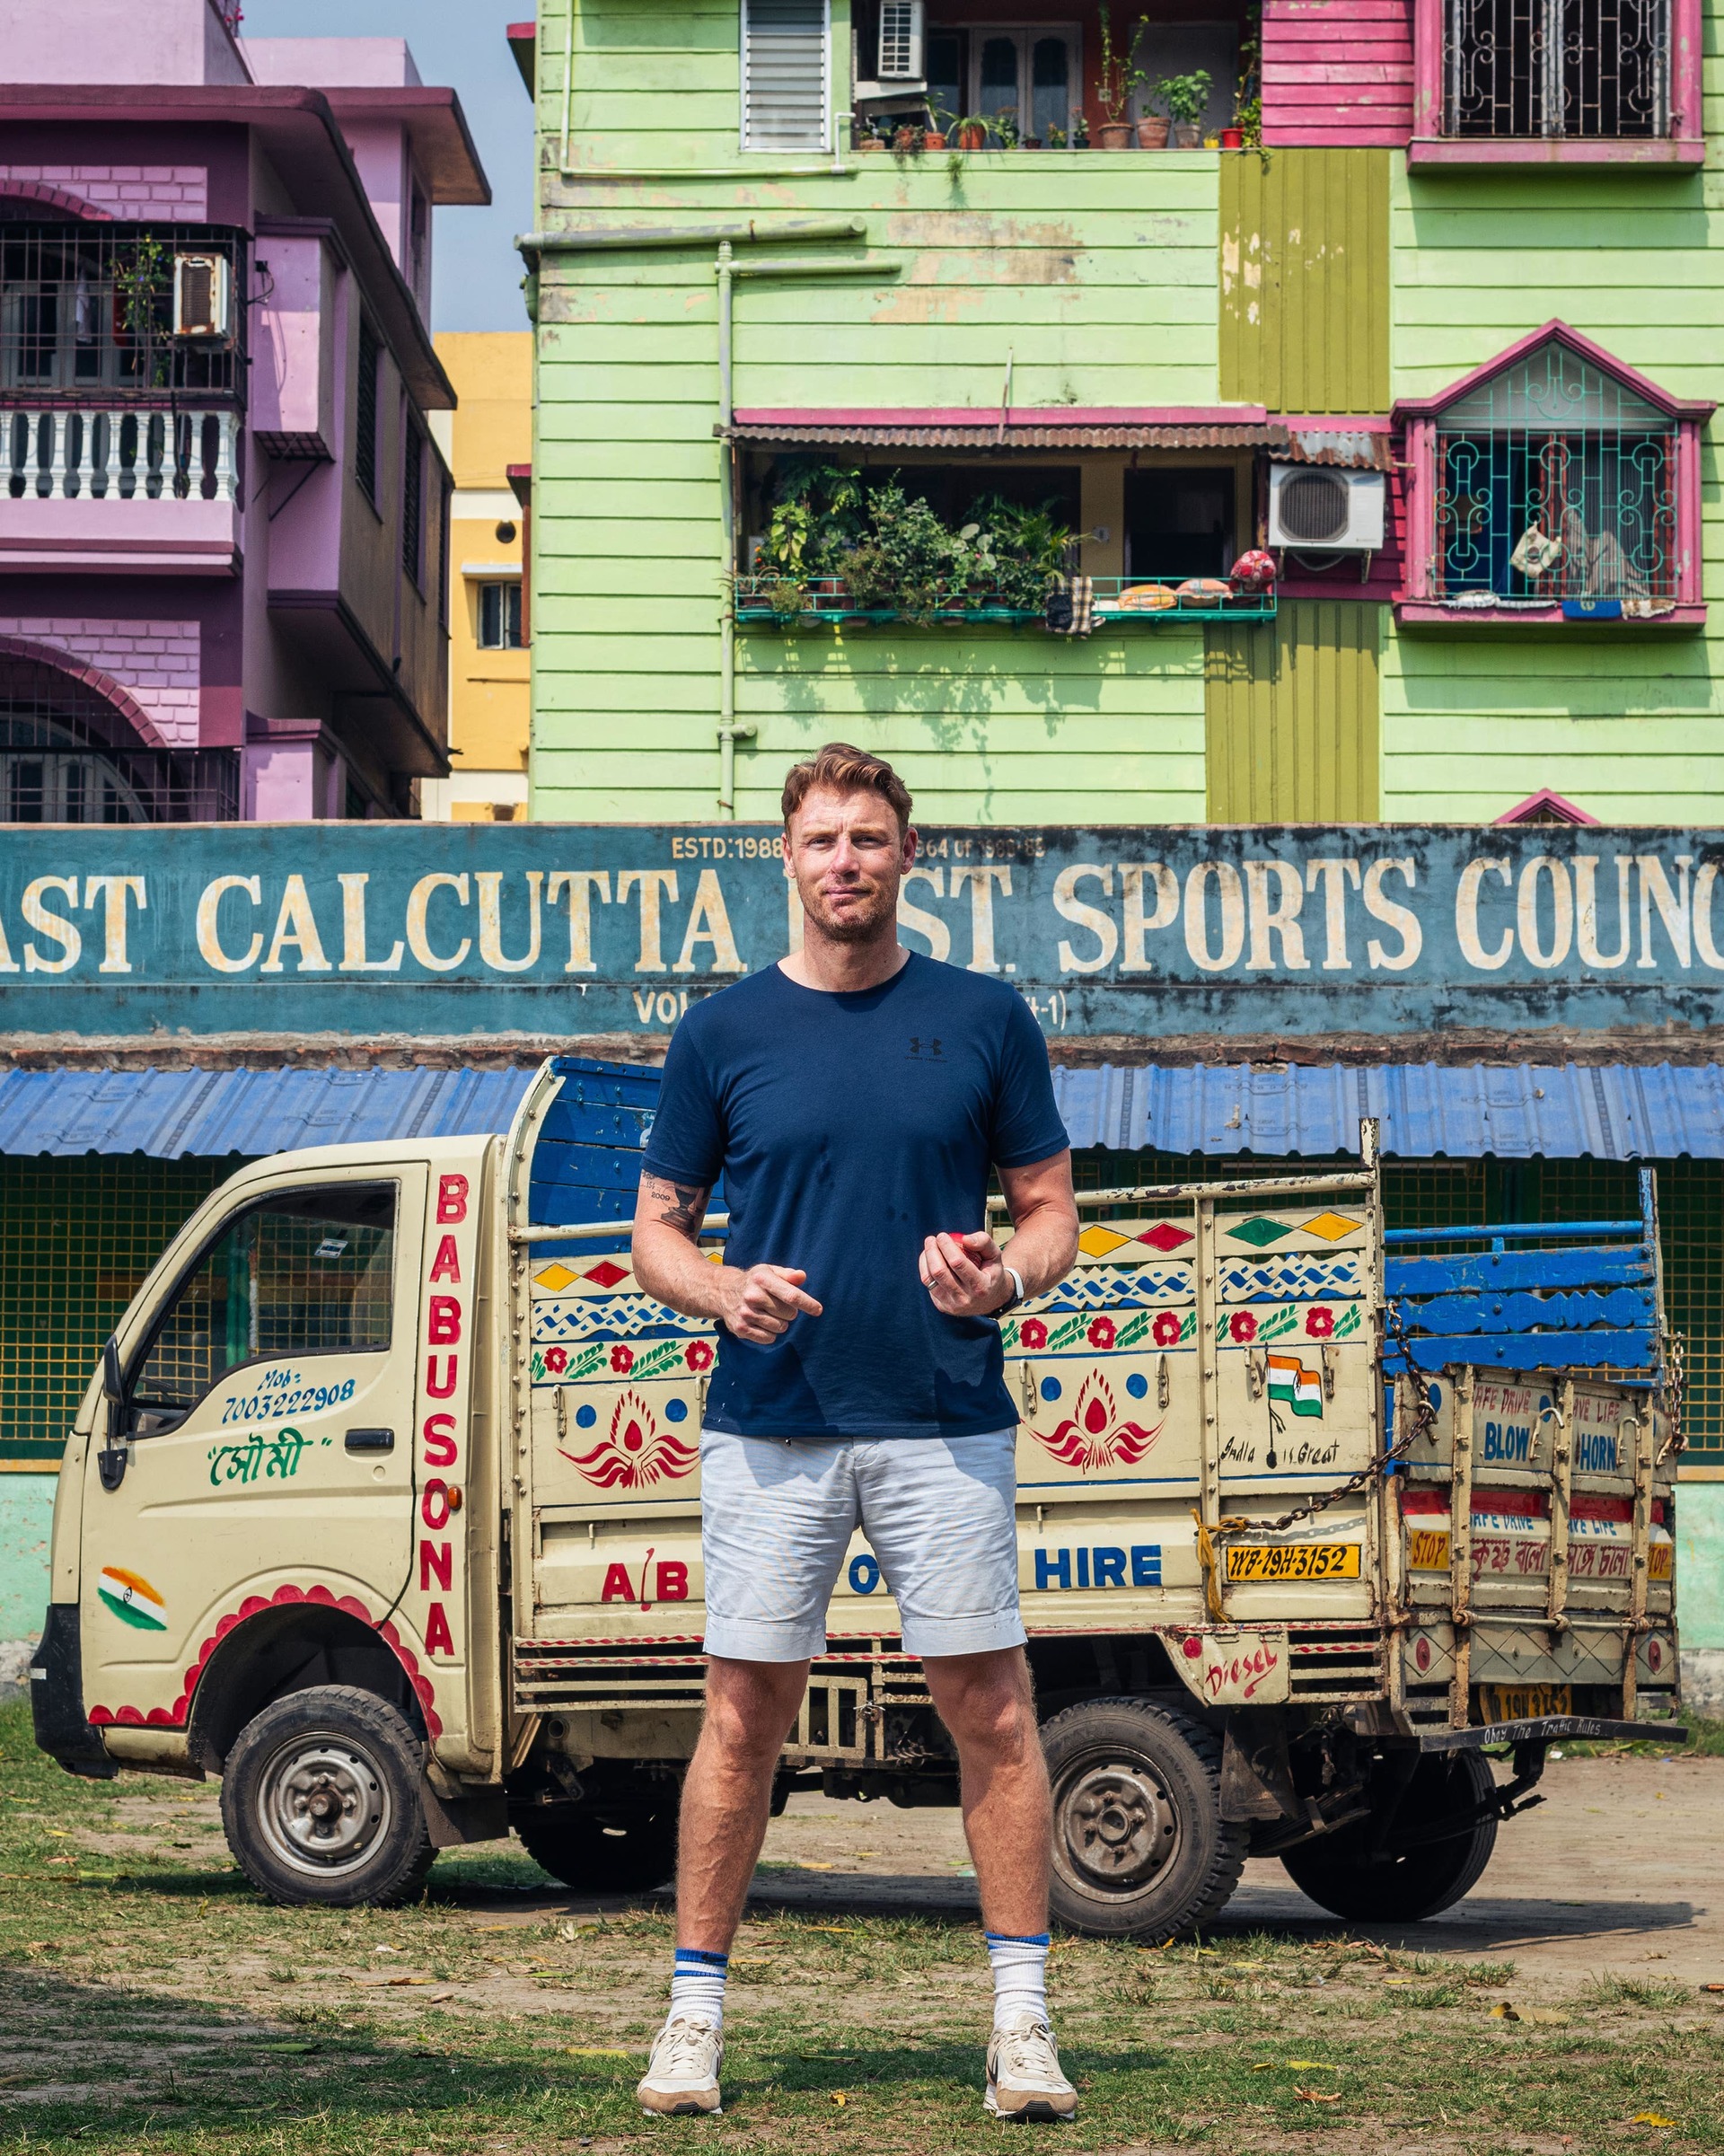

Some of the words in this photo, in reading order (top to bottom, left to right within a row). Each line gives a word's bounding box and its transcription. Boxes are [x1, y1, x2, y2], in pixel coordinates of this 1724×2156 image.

[196, 867, 748, 973] CALCUTTA
[1052, 856, 1424, 973] SPORTS
[222, 1378, 356, 1424] 7003222908
[420, 1174, 469, 1657] BABUSONA
[1472, 1384, 1498, 1411] AFE
[1297, 1440, 1340, 1465] Great
[1484, 1421, 1530, 1462] BLOW
[1579, 1433, 1616, 1471] HORN
[1034, 1544, 1164, 1590] HIRE
[1412, 1531, 1447, 1566] STOP
[1649, 1546, 1668, 1574] TOP
[1484, 1728, 1507, 1745] Obey
[1513, 1724, 1531, 1740] The
